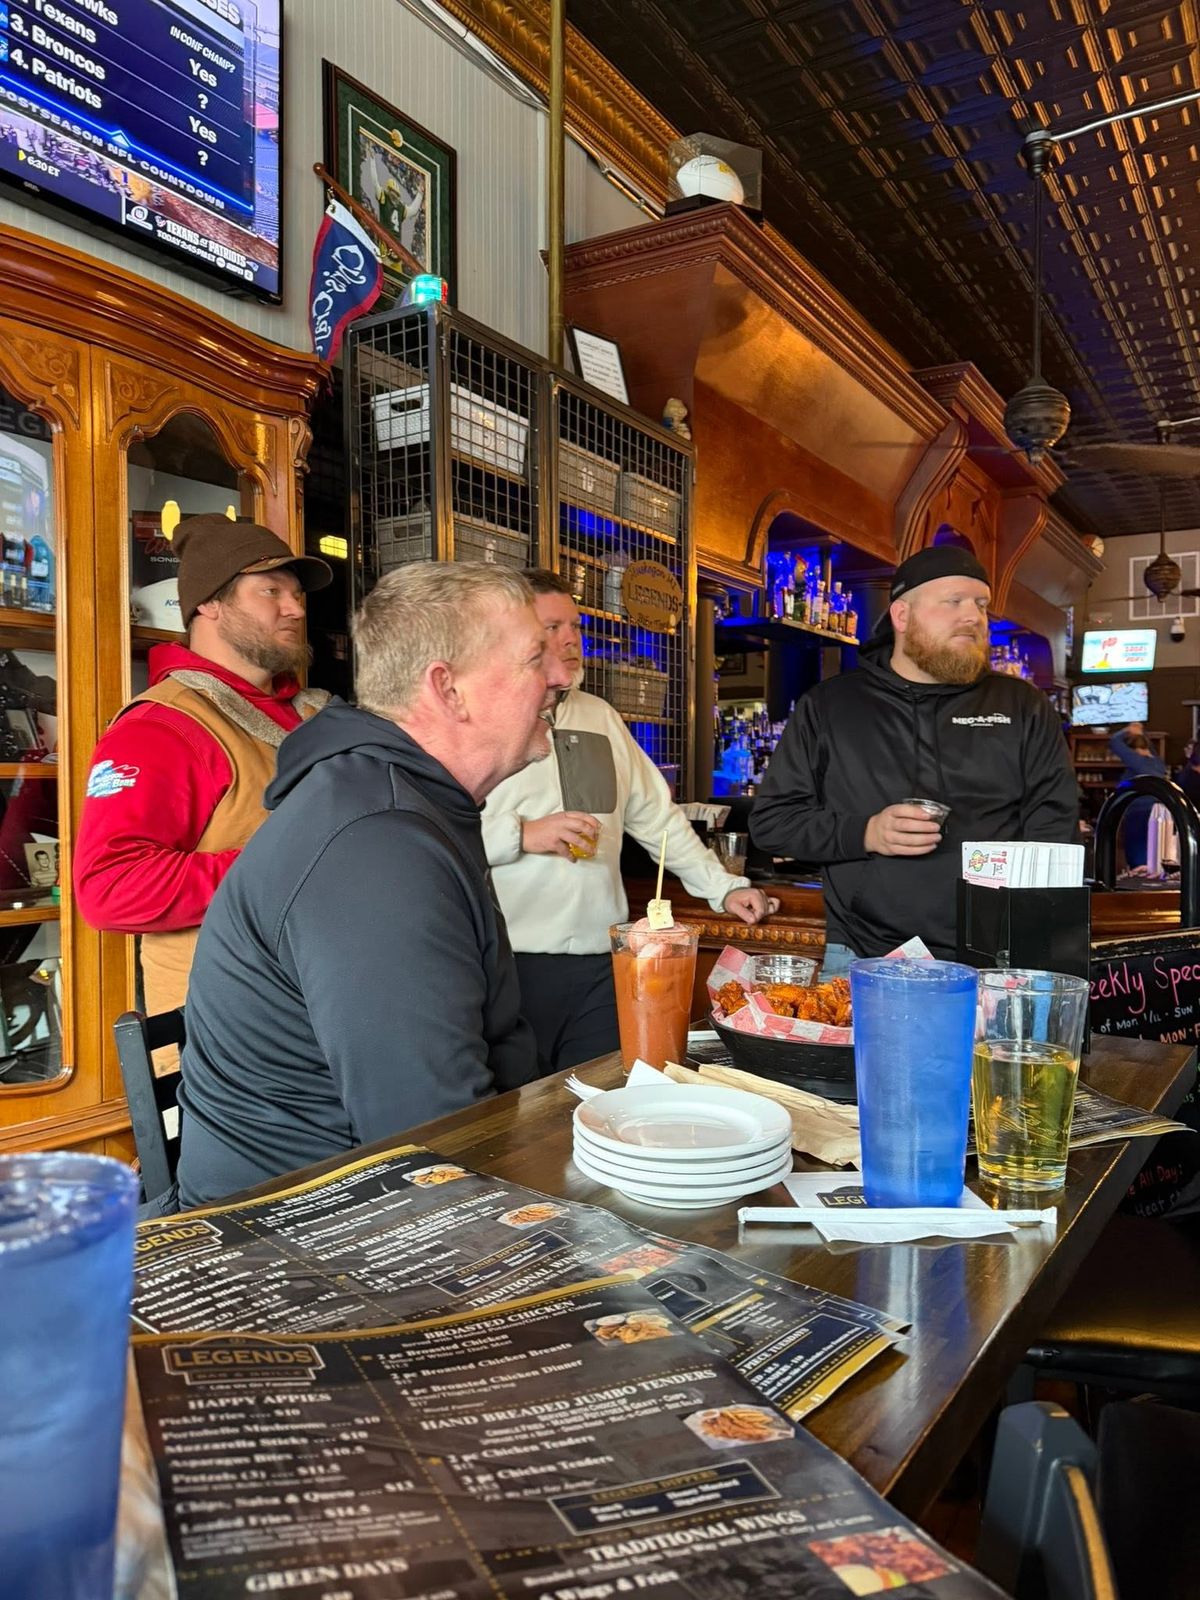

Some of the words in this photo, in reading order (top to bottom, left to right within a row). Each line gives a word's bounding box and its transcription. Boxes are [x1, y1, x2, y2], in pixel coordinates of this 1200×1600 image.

[35, 0, 96, 43] Texans
[10, 13, 29, 36] 3.
[32, 25, 105, 80] Broncos
[170, 26, 180, 39] IN
[180, 33, 203, 52] CONF
[202, 47, 236, 73] CHAMP?
[10, 49, 29, 70] 4.
[32, 58, 102, 108] Patriots
[189, 59, 218, 88] Yes
[198, 94, 208, 109] ?
[189, 116, 218, 144] Yes
[198, 151, 208, 166] ?
[107, 143, 137, 164] NFL
[140, 160, 225, 210] COUNTDOWN
[166, 219, 200, 247] TEXANS
[208, 240, 247, 268] PATRIOTS
[1090, 962, 1147, 1014] eekly
[1100, 1019, 1111, 1033] of
[1116, 1018, 1139, 1031] Mon
[282, 1181, 342, 1204] BROASTED
[341, 1163, 392, 1186] CHICKEN
[276, 1203, 316, 1218] Broasted
[315, 1192, 350, 1206] Chicken
[296, 1213, 335, 1228] Broasted
[335, 1202, 371, 1216] Chicken
[370, 1189, 401, 1203] Breasts
[309, 1222, 350, 1237] Broasted
[350, 1210, 385, 1224] Chicken
[383, 1198, 413, 1212] Dinner
[134, 1225, 211, 1251] GENDS
[317, 1244, 357, 1262] HAND
[359, 1222, 416, 1248] BREADED
[414, 1205, 459, 1228] JUMBO
[457, 1190, 509, 1211] TENDERS
[140, 1267, 191, 1289] HAPPY
[195, 1251, 244, 1270] APPIES
[370, 1253, 409, 1270] Chicken
[407, 1239, 443, 1256] Tenders
[388, 1262, 426, 1280] Chicken
[424, 1248, 462, 1267] Tenders
[138, 1290, 194, 1313] Portobello
[193, 1271, 253, 1293] Mushrooms
[163, 1280, 191, 1292] Fries
[465, 1267, 552, 1307] TRADITIONAL
[551, 1249, 592, 1270] WINGS
[147, 1296, 213, 1321] Mozzarella
[212, 1284, 247, 1299] Sticks
[160, 1307, 216, 1328] Asparagus
[215, 1297, 244, 1309] Bites
[267, 1305, 301, 1319] Queso
[423, 1317, 505, 1340] BROASTED
[508, 1300, 576, 1321] CHICKEN
[173, 1350, 313, 1367] LEGENDS
[388, 1352, 405, 1361] pc
[406, 1342, 460, 1357] Broasted
[461, 1333, 510, 1347] Chicken
[401, 1370, 418, 1381] pc
[420, 1362, 477, 1378] Broasted
[477, 1352, 528, 1368] Chicken
[527, 1342, 574, 1357] Breasts
[744, 1352, 772, 1370] PIECE
[411, 1387, 428, 1398] pc
[430, 1379, 488, 1394] Broasted
[490, 1368, 541, 1385] Chicken
[541, 1358, 584, 1374] Dinner
[188, 1396, 257, 1410] HAPPY
[263, 1393, 332, 1405] APPIES
[419, 1415, 479, 1431] HAND
[481, 1401, 572, 1423] BREADED
[574, 1385, 638, 1407] JUMBO
[637, 1369, 718, 1392] TENDERS
[158, 1415, 205, 1427] Pickle
[208, 1411, 246, 1422] Fries
[273, 1409, 301, 1418] $10
[161, 1426, 240, 1441] Portobello
[243, 1421, 327, 1433] Mushrooms
[354, 1416, 381, 1425] $10
[164, 1439, 257, 1455] Mozzarella
[259, 1436, 309, 1447] Sticks
[339, 1431, 369, 1441] $10
[169, 1456, 251, 1470] Asparagus
[253, 1452, 293, 1464] Bites
[322, 1446, 366, 1458] $10.5
[461, 1453, 479, 1464] pc
[481, 1442, 541, 1459] Chicken
[541, 1434, 596, 1450] Tenders
[172, 1471, 238, 1484] Pretzels
[241, 1470, 267, 1481] (3)
[296, 1463, 341, 1476] $11.5
[475, 1472, 495, 1485] pc
[496, 1462, 558, 1480] Chicken
[557, 1454, 615, 1471] Tenders
[174, 1500, 233, 1515] Chips,
[234, 1495, 282, 1509] Salsa
[284, 1493, 300, 1505] &
[303, 1488, 356, 1503] Queso
[384, 1480, 415, 1493] $13
[179, 1516, 245, 1535] Loaded
[248, 1513, 293, 1526] Fries
[323, 1504, 372, 1518] $14.5
[583, 1521, 736, 1562] TRADITIONAL
[734, 1510, 807, 1534] WINGS
[522, 1570, 576, 1588] Breaded
[591, 1558, 630, 1573] Naked
[779, 1524, 816, 1537] Celery
[815, 1519, 835, 1531] and
[244, 1566, 340, 1593] GREEN
[342, 1556, 410, 1579] DAYS
[555, 1580, 615, 1600] Wings
[615, 1577, 635, 1592] &
[634, 1569, 680, 1589] Fries
